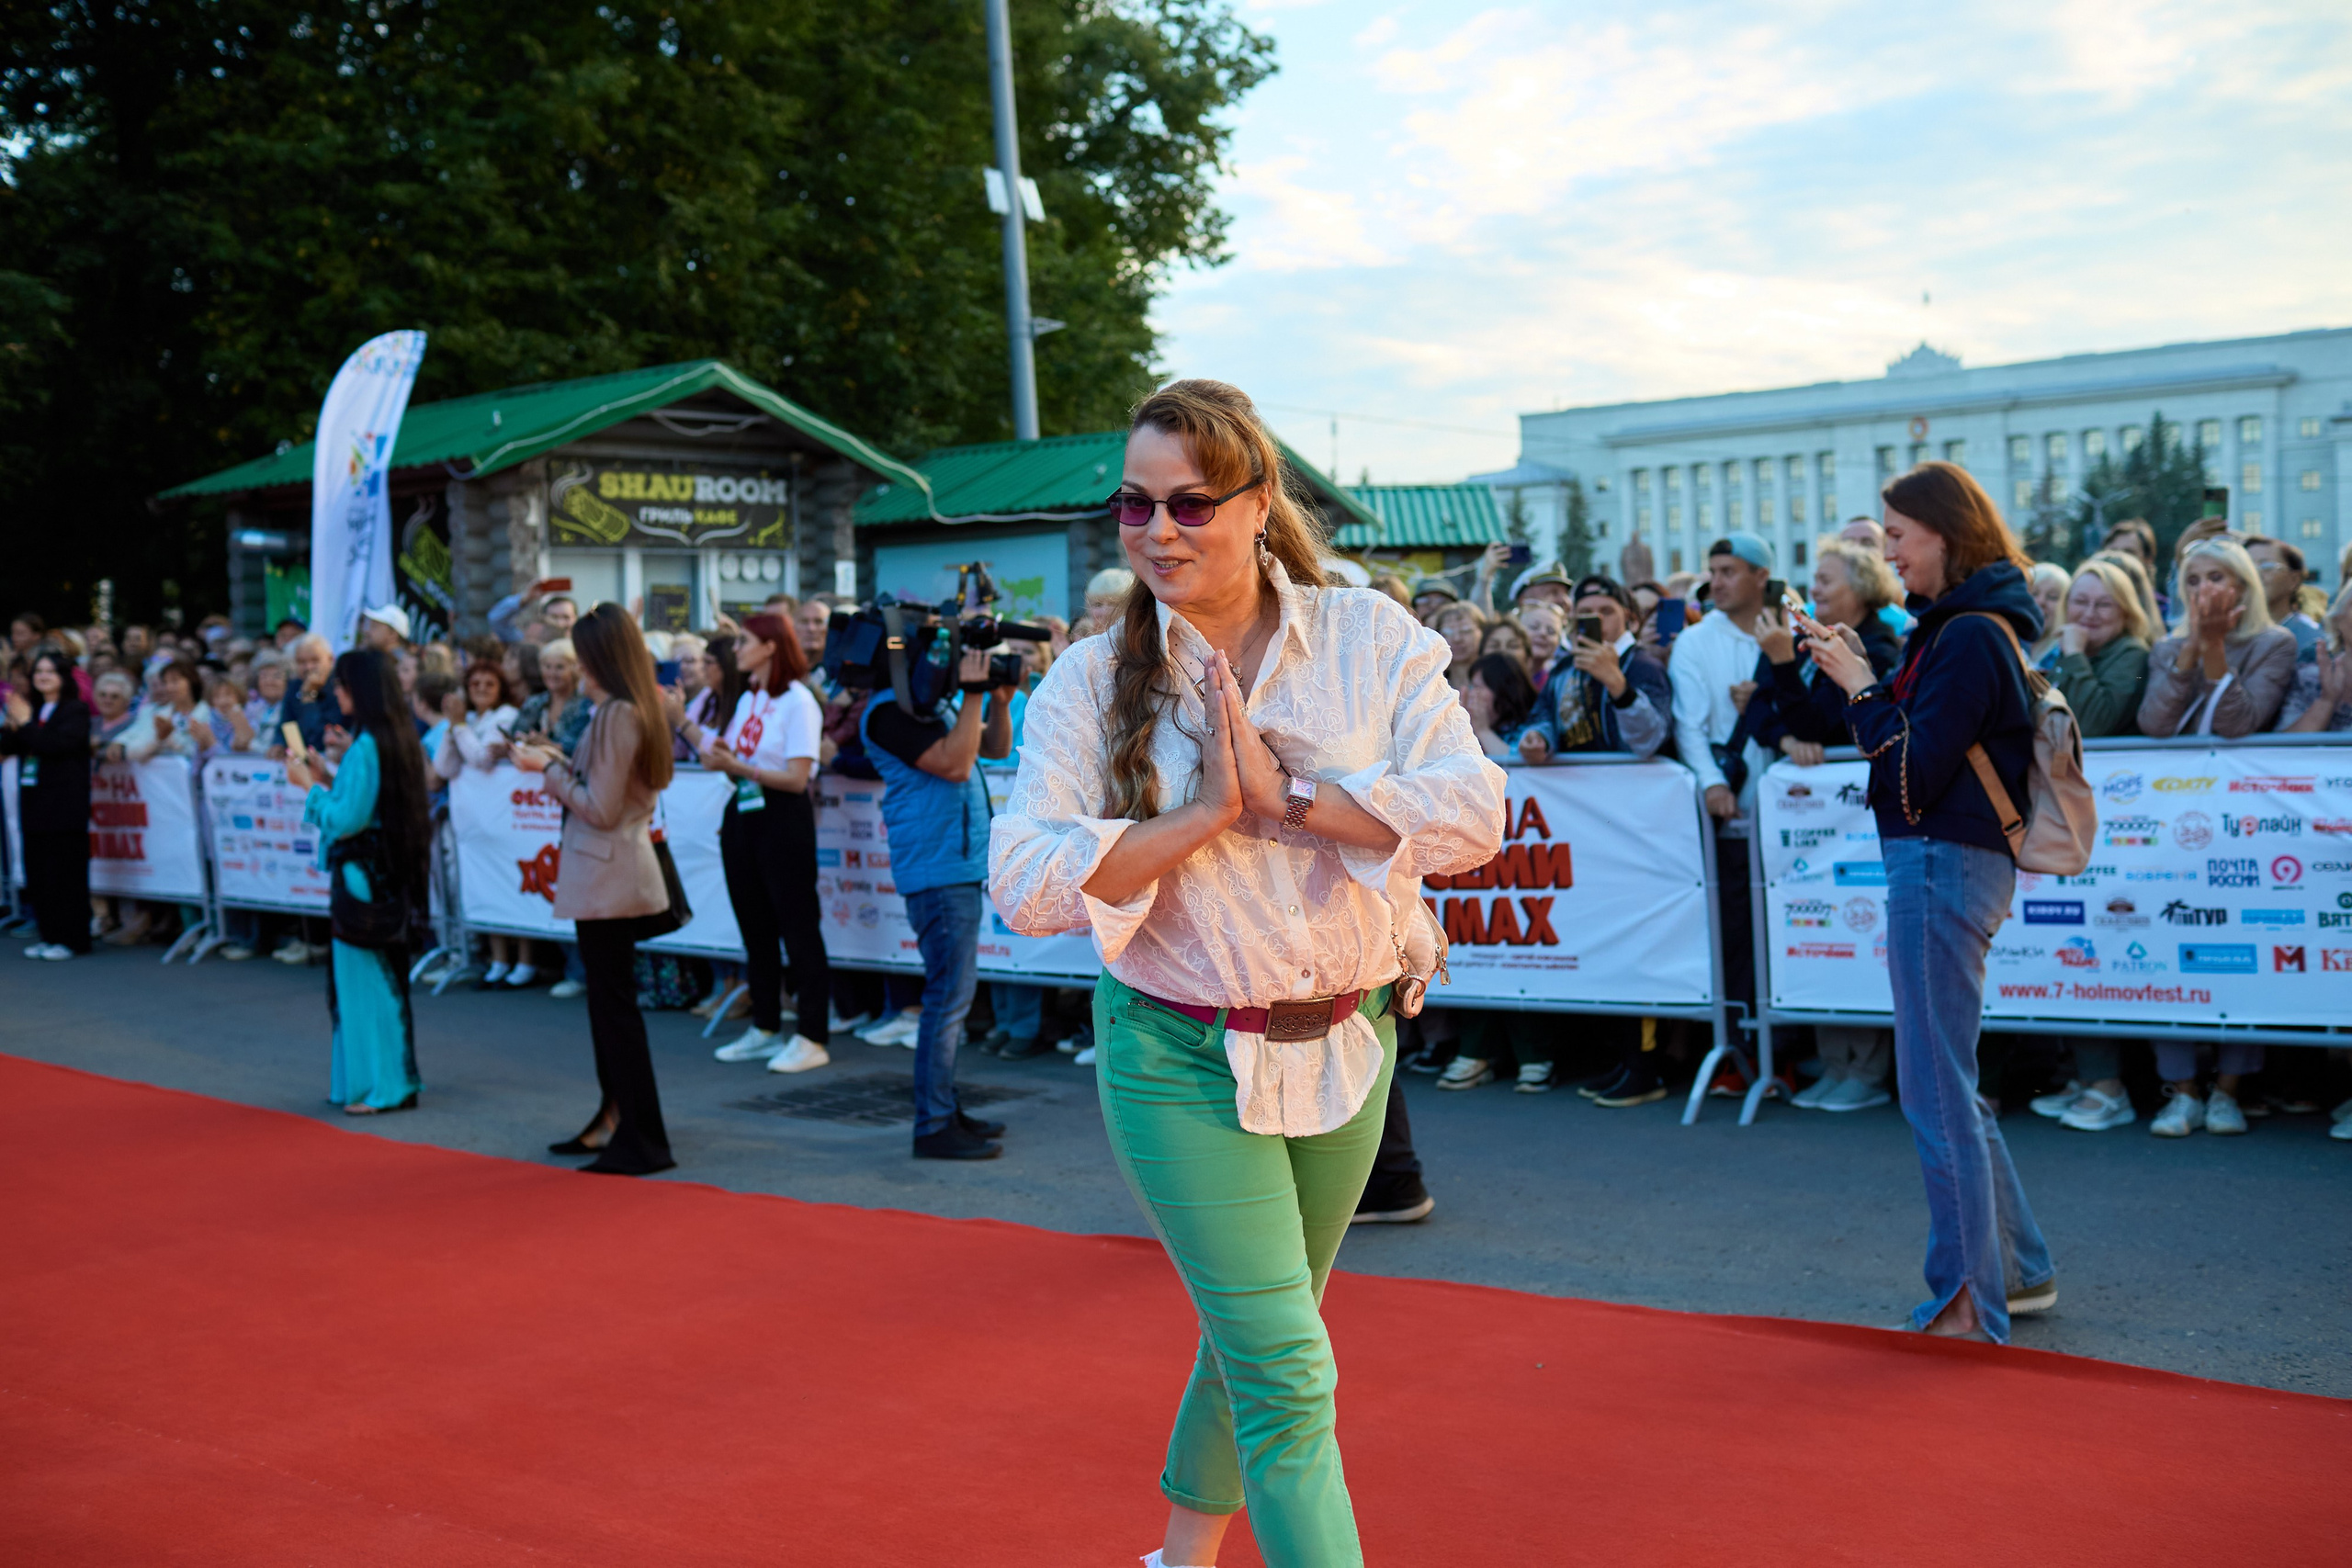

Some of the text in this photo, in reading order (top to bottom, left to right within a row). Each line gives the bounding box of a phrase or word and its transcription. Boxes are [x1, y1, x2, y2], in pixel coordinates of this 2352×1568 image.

[2207, 858, 2258, 873] ПОЧТА
[2208, 874, 2260, 888] РОССИИ
[2318, 912, 2352, 929] ВЯТ
[1999, 981, 2211, 1004] www.7-holmovfest.ru
